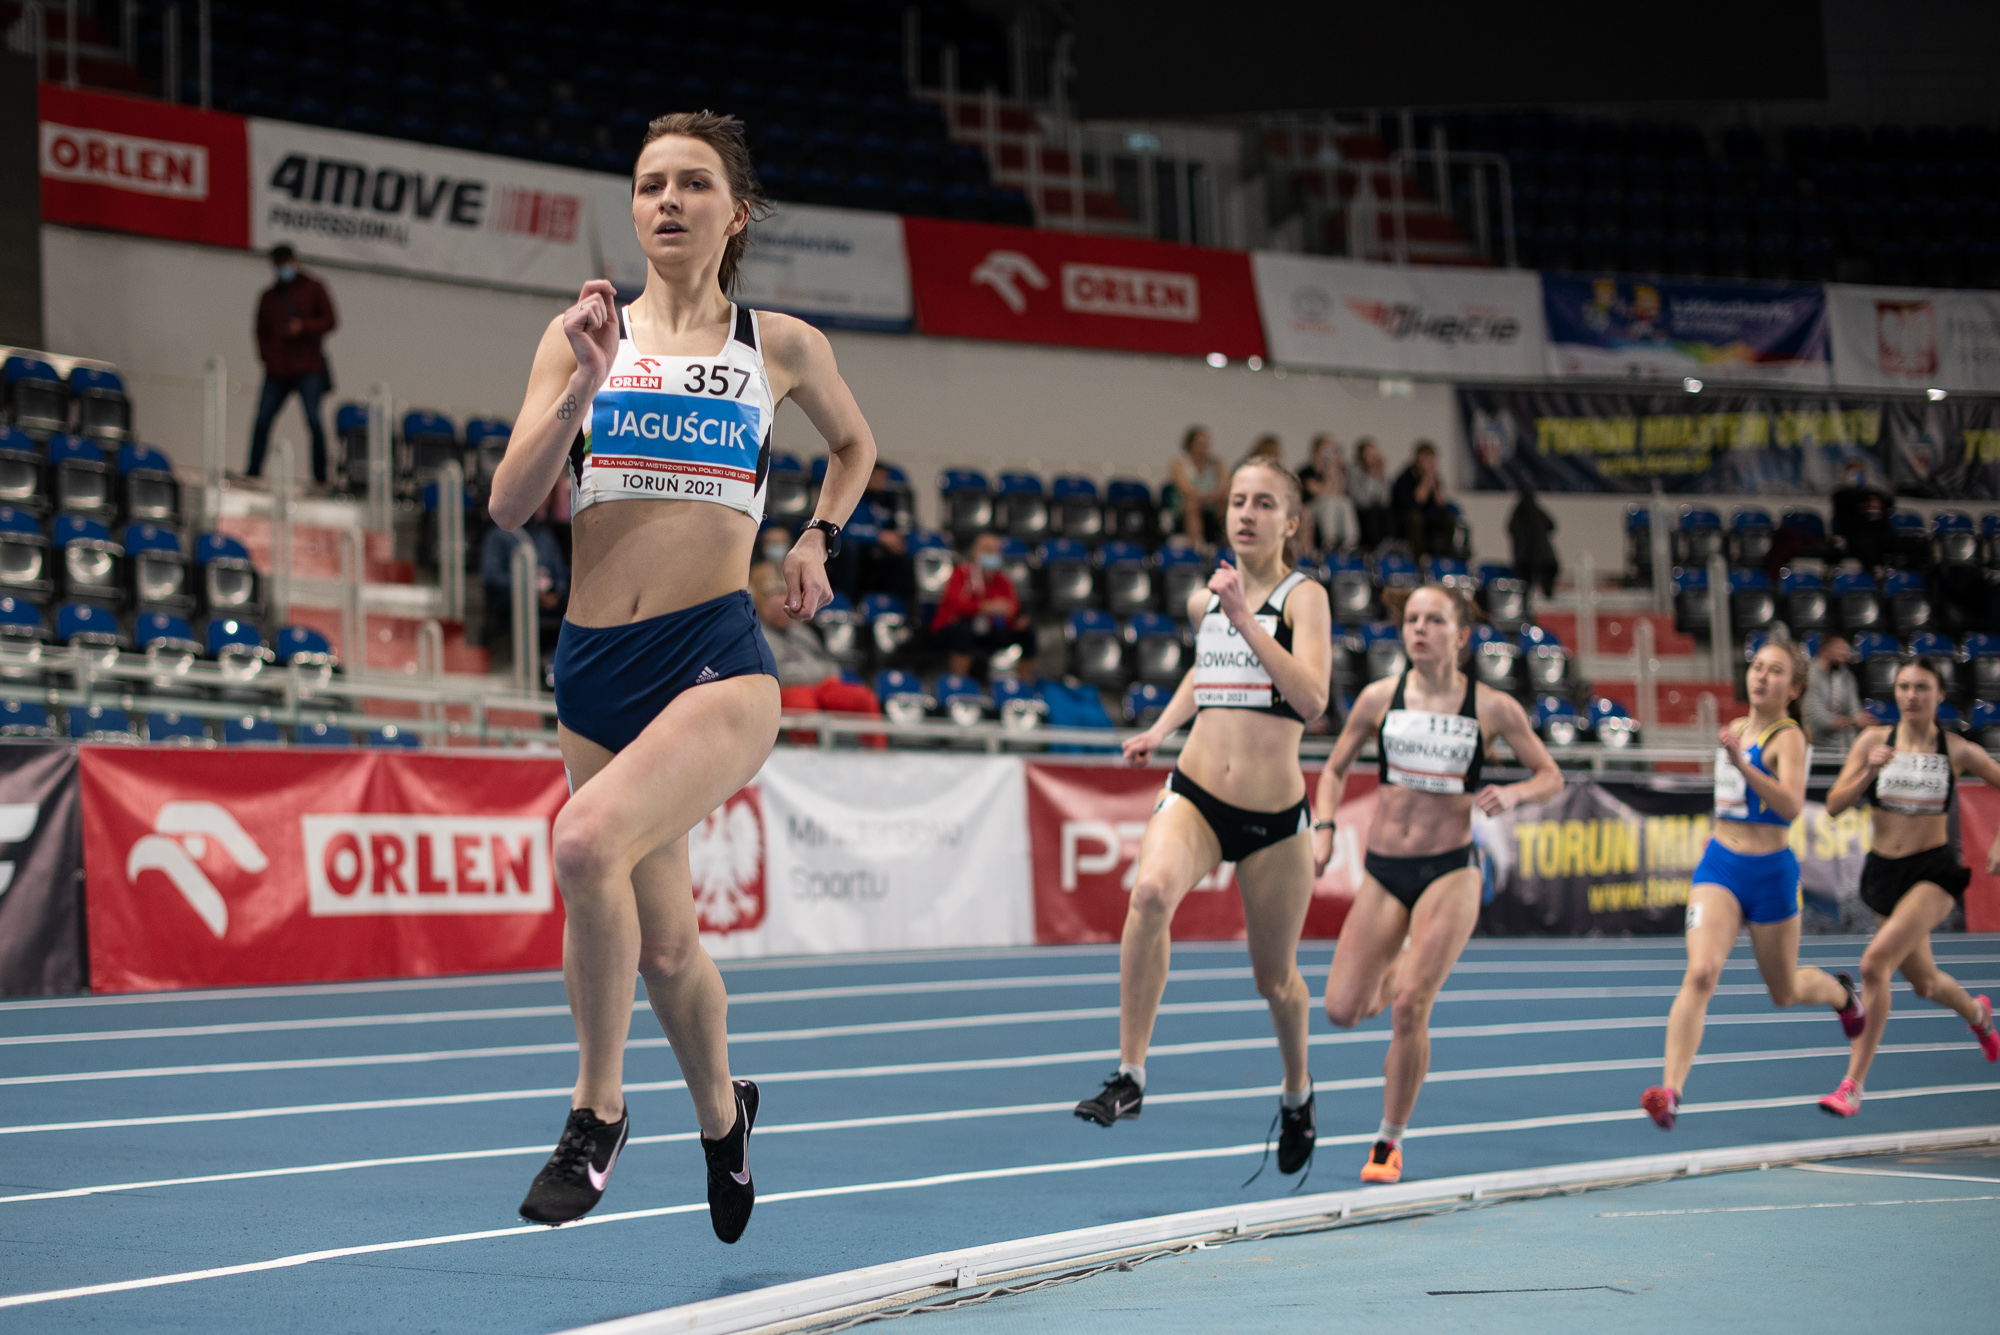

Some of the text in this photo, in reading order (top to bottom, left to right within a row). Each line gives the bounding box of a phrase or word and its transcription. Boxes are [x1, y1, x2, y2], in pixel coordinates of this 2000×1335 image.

[52, 136, 192, 186] ORLEN
[271, 154, 485, 228] 4MOVE
[1074, 275, 1187, 308] ORLEN
[612, 364, 751, 399] ORLEN 357
[608, 410, 747, 450] JAGUŚCIK
[616, 459, 645, 468] HALOWE
[645, 462, 698, 473] MISTRZOSTWA
[698, 467, 724, 476] POLSKI
[737, 472, 750, 480] U20
[622, 474, 723, 497] TORUŃ 2021
[695, 671, 719, 684] adidas
[1227, 692, 1248, 702] 2021
[1428, 716, 1475, 738] 1122
[323, 832, 534, 896] ORLEN
[789, 865, 889, 903] Sportu
